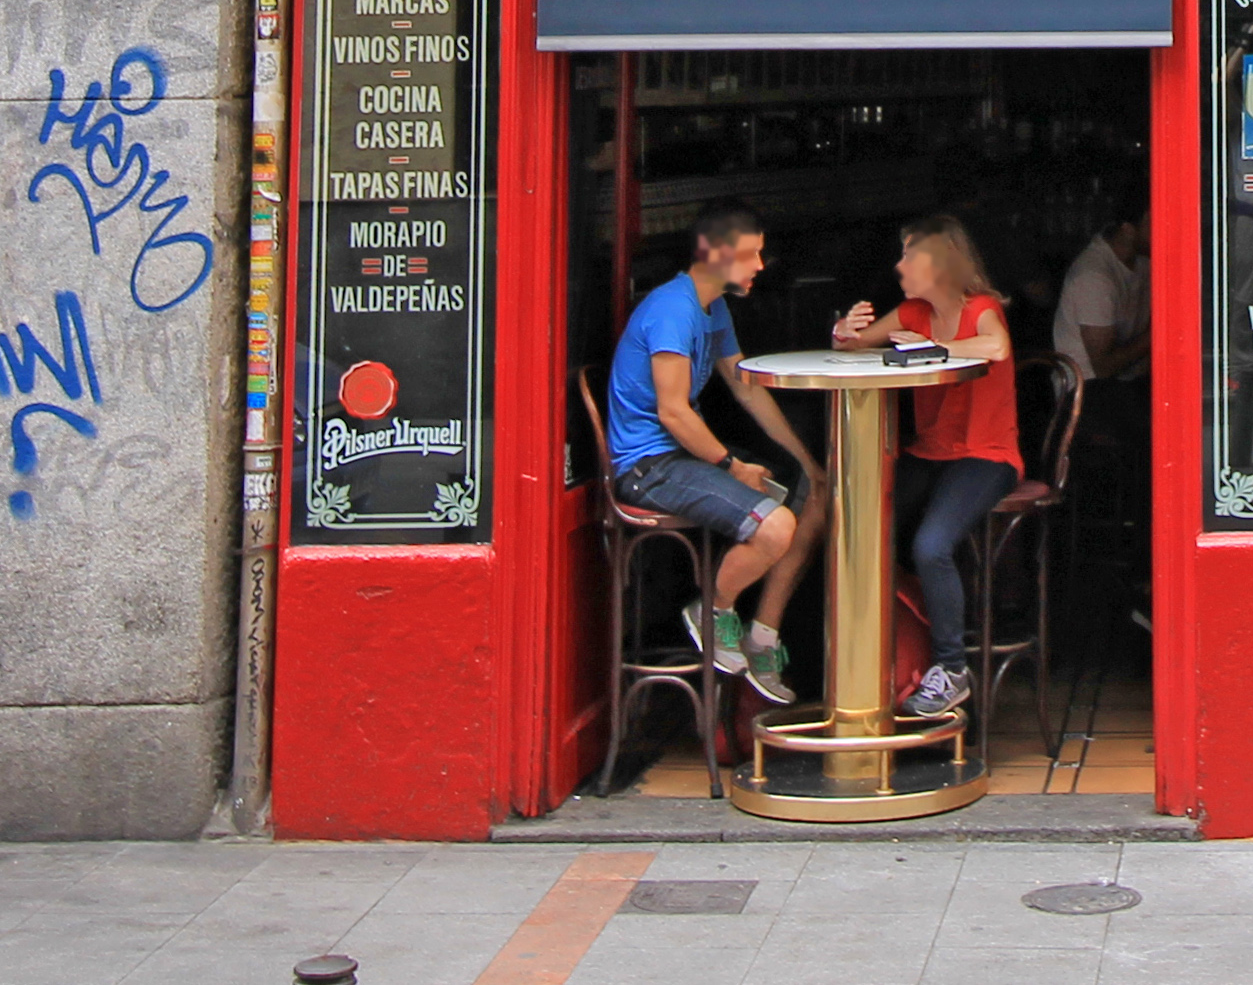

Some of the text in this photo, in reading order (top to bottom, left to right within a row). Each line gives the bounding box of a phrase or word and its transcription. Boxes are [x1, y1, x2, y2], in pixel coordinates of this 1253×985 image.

[334, 35, 470, 64] VINOS FINOS
[358, 86, 442, 114] COCINA
[355, 120, 445, 150] CASERA
[330, 170, 469, 200] TAPAS FINAS
[350, 221, 446, 249] MORAPIO
[382, 254, 406, 277] DE
[331, 279, 464, 314] VALDEPEÑAS
[322, 417, 463, 471] Pilsner Urquell
